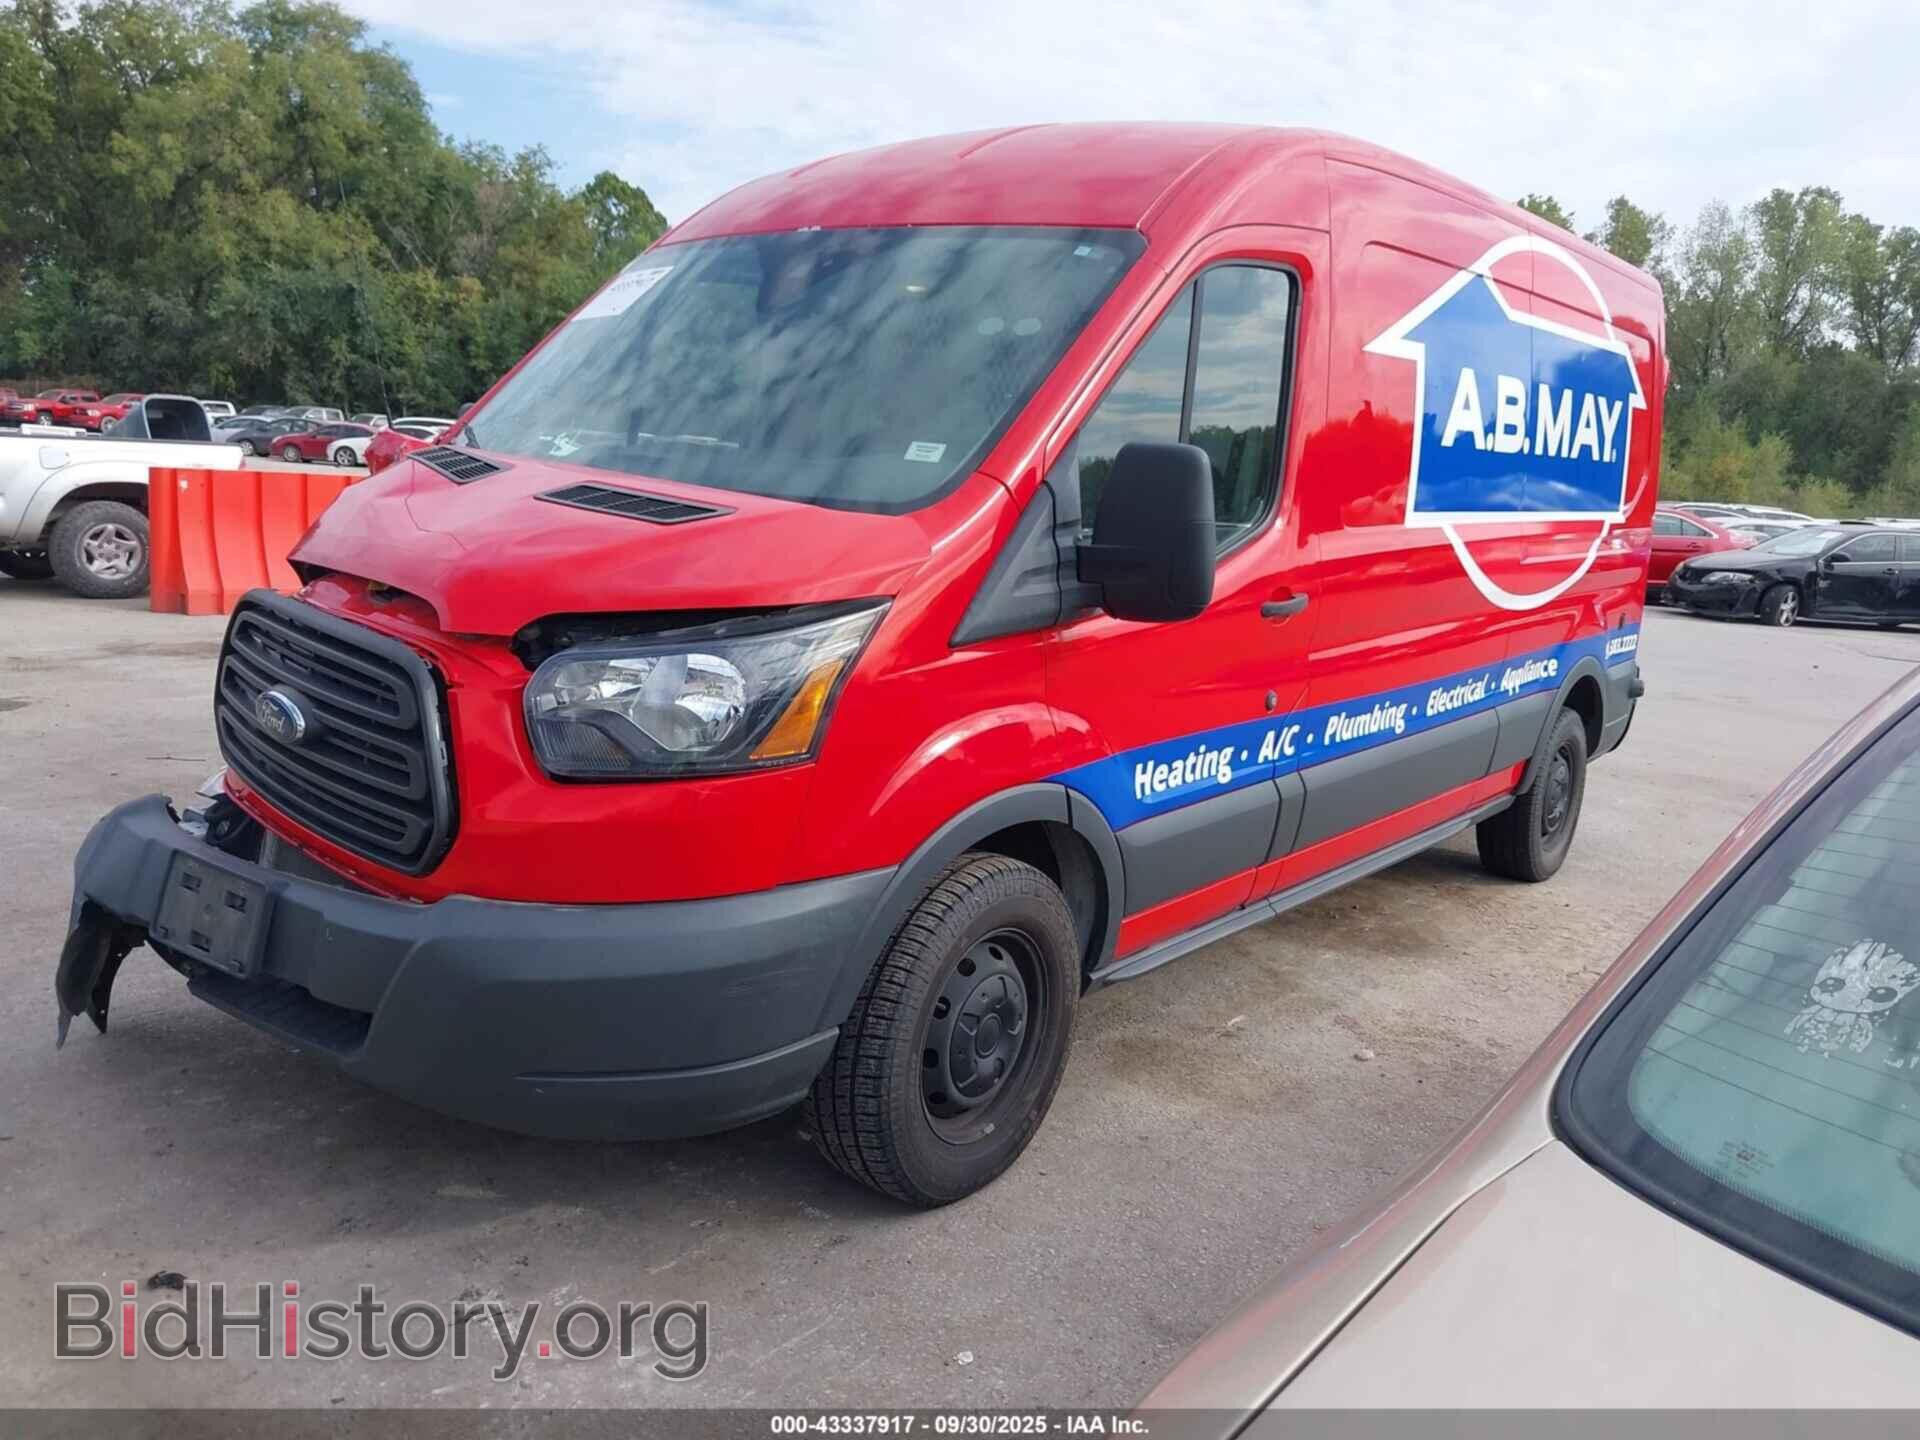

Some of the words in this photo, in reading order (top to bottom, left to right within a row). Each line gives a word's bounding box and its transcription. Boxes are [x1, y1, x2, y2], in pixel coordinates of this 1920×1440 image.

[1135, 744, 1235, 800] Heating
[1257, 725, 1300, 763] A/C
[1324, 701, 1408, 745] Plumbing
[1426, 673, 1489, 717] Electrical
[1500, 657, 1558, 696] Appliance
